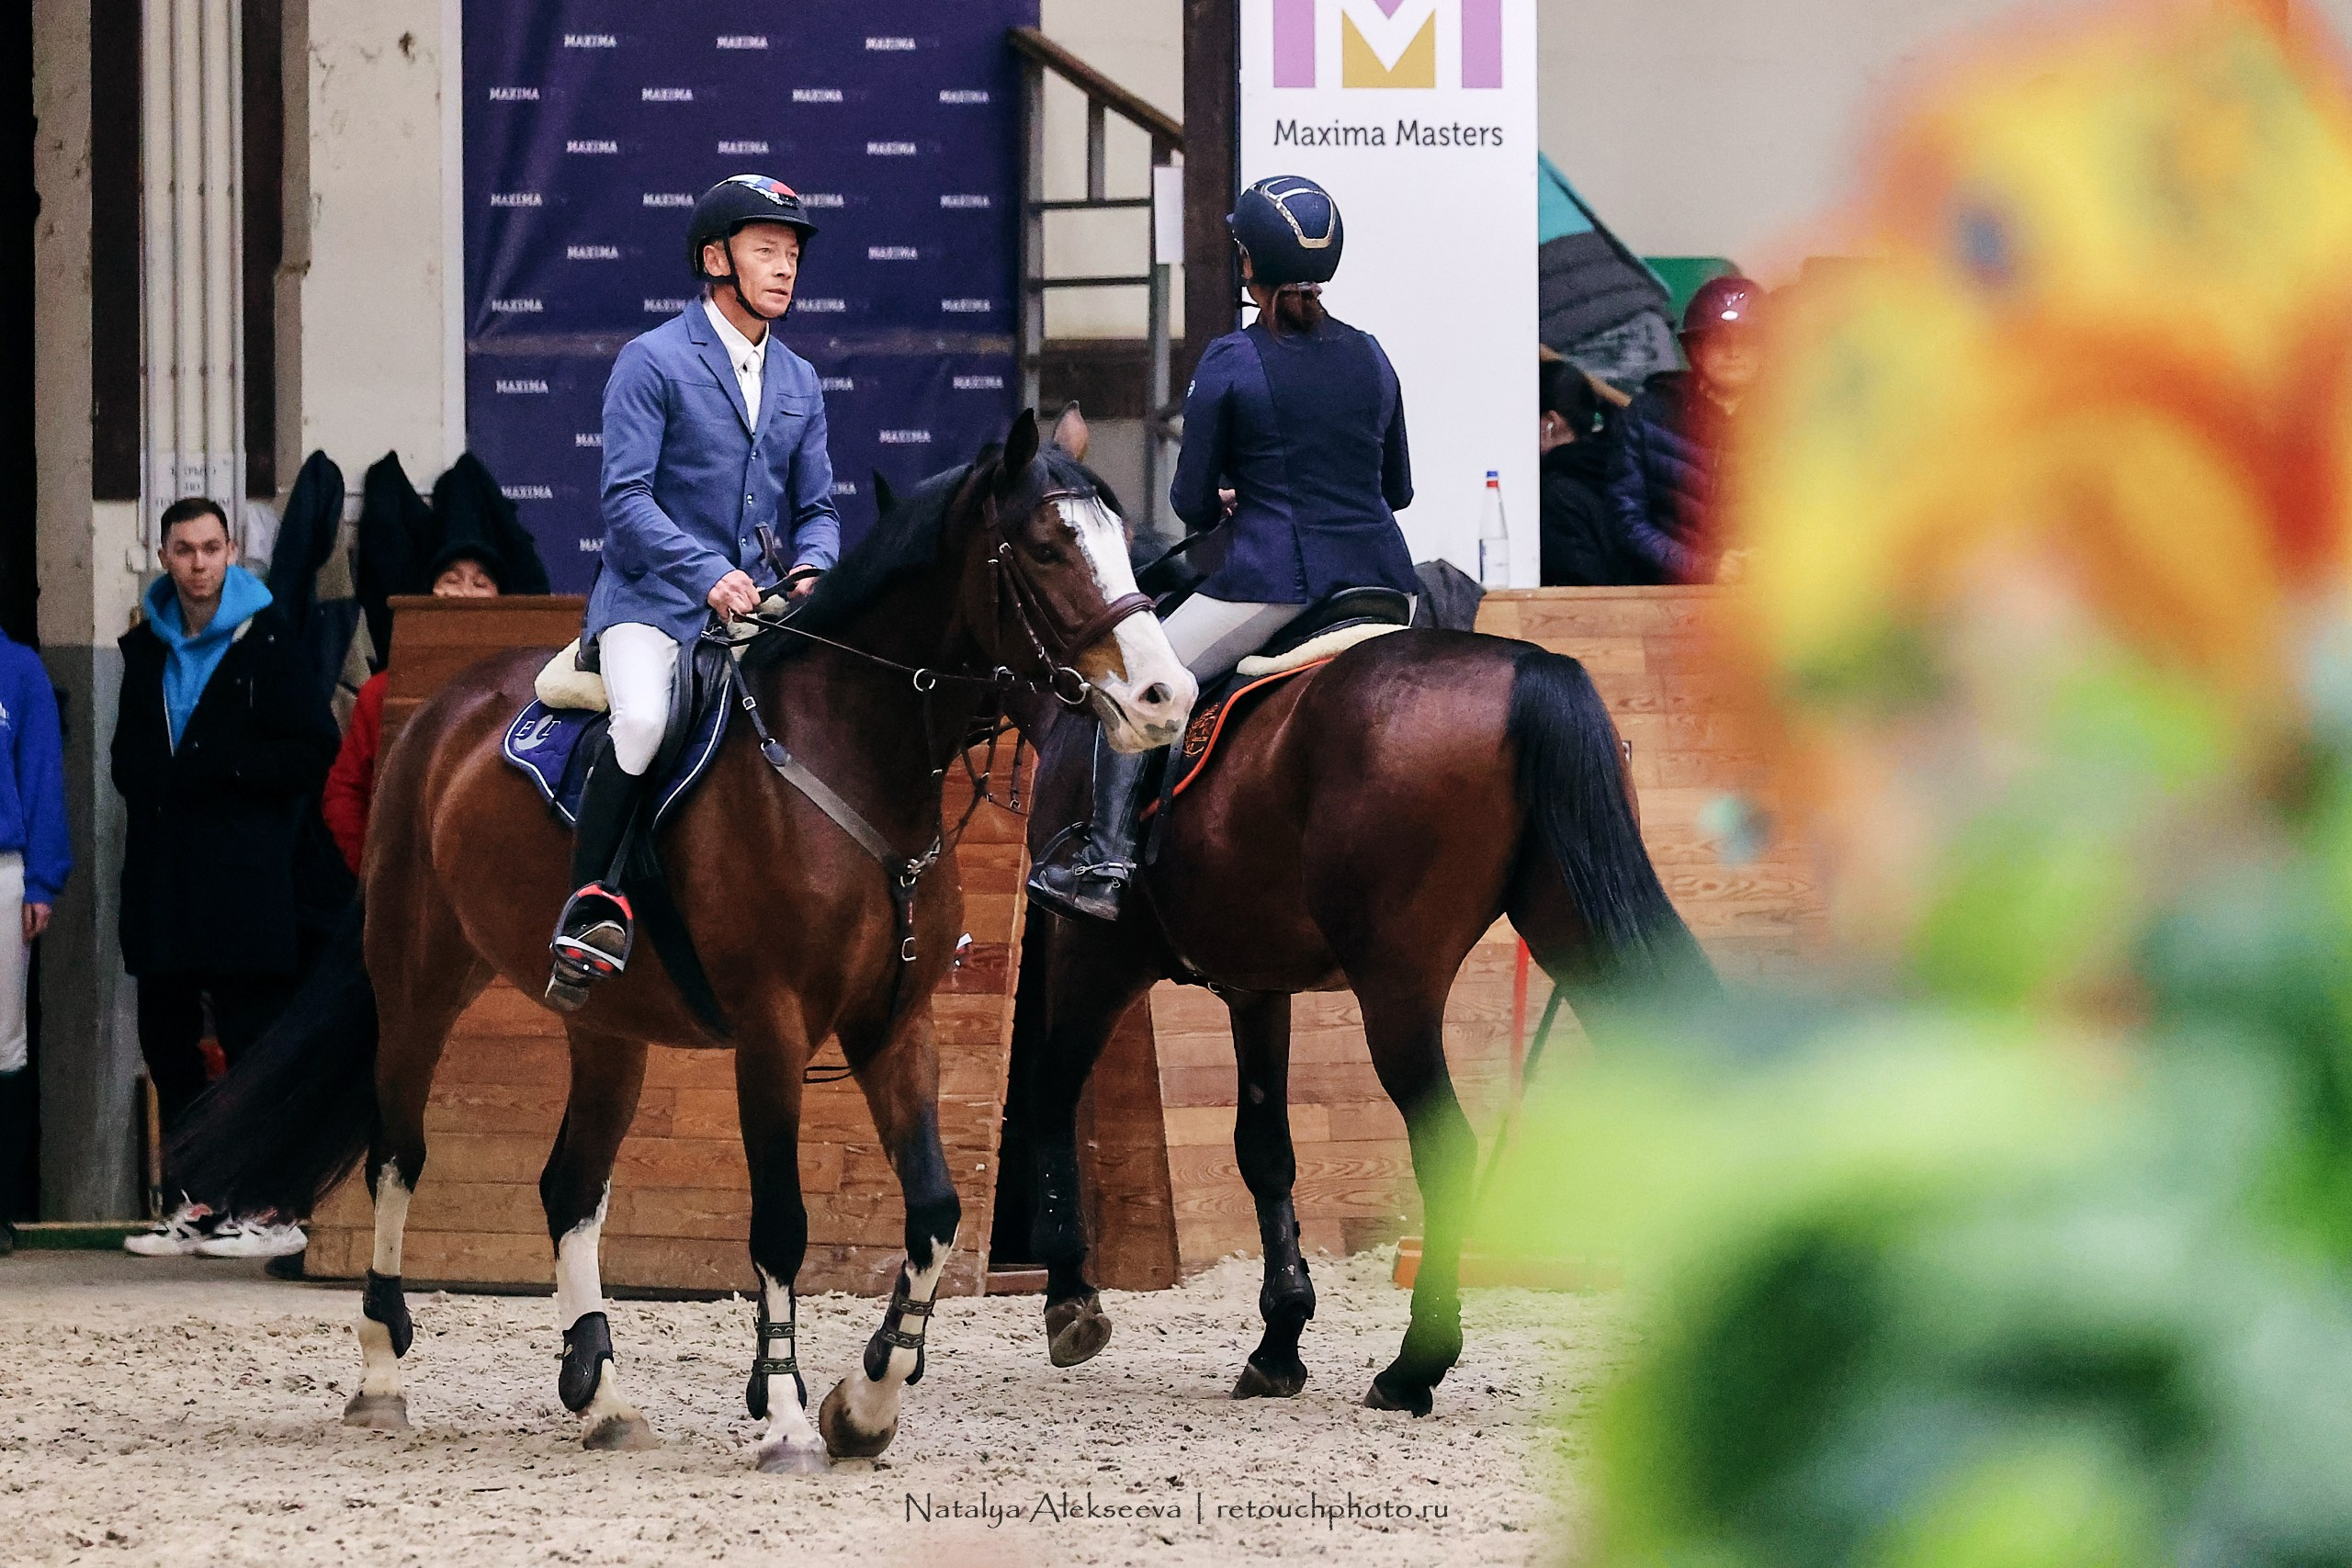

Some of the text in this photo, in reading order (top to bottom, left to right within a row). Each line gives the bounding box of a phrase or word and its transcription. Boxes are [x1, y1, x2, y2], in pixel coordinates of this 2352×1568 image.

[564, 33, 617, 48] MAXIMA
[717, 35, 768, 49] MAXIMA
[865, 38, 916, 51] MAXIMA
[490, 87, 539, 100] MAXIMA
[642, 88, 693, 101] MAXIMA
[793, 88, 842, 102] MAXIMA
[939, 90, 989, 103] MAXIMA
[1273, 119, 1503, 146] Maxima Masters
[567, 140, 618, 153] MAXIMA
[718, 141, 769, 153] MAXIMA
[867, 141, 916, 155] MAXIMA
[491, 194, 542, 207] MAXIMA
[941, 195, 989, 208] MAXIMA
[567, 246, 618, 259] MAXIMA
[868, 246, 918, 260] MAXIMA
[492, 299, 543, 312] MAXIMA
[644, 299, 687, 312] MAXIM
[942, 299, 990, 312] MAXIMA
[496, 379, 548, 393] MAXIMA
[954, 376, 1003, 389] MAXIMA
[879, 430, 931, 443] MAXIMA
